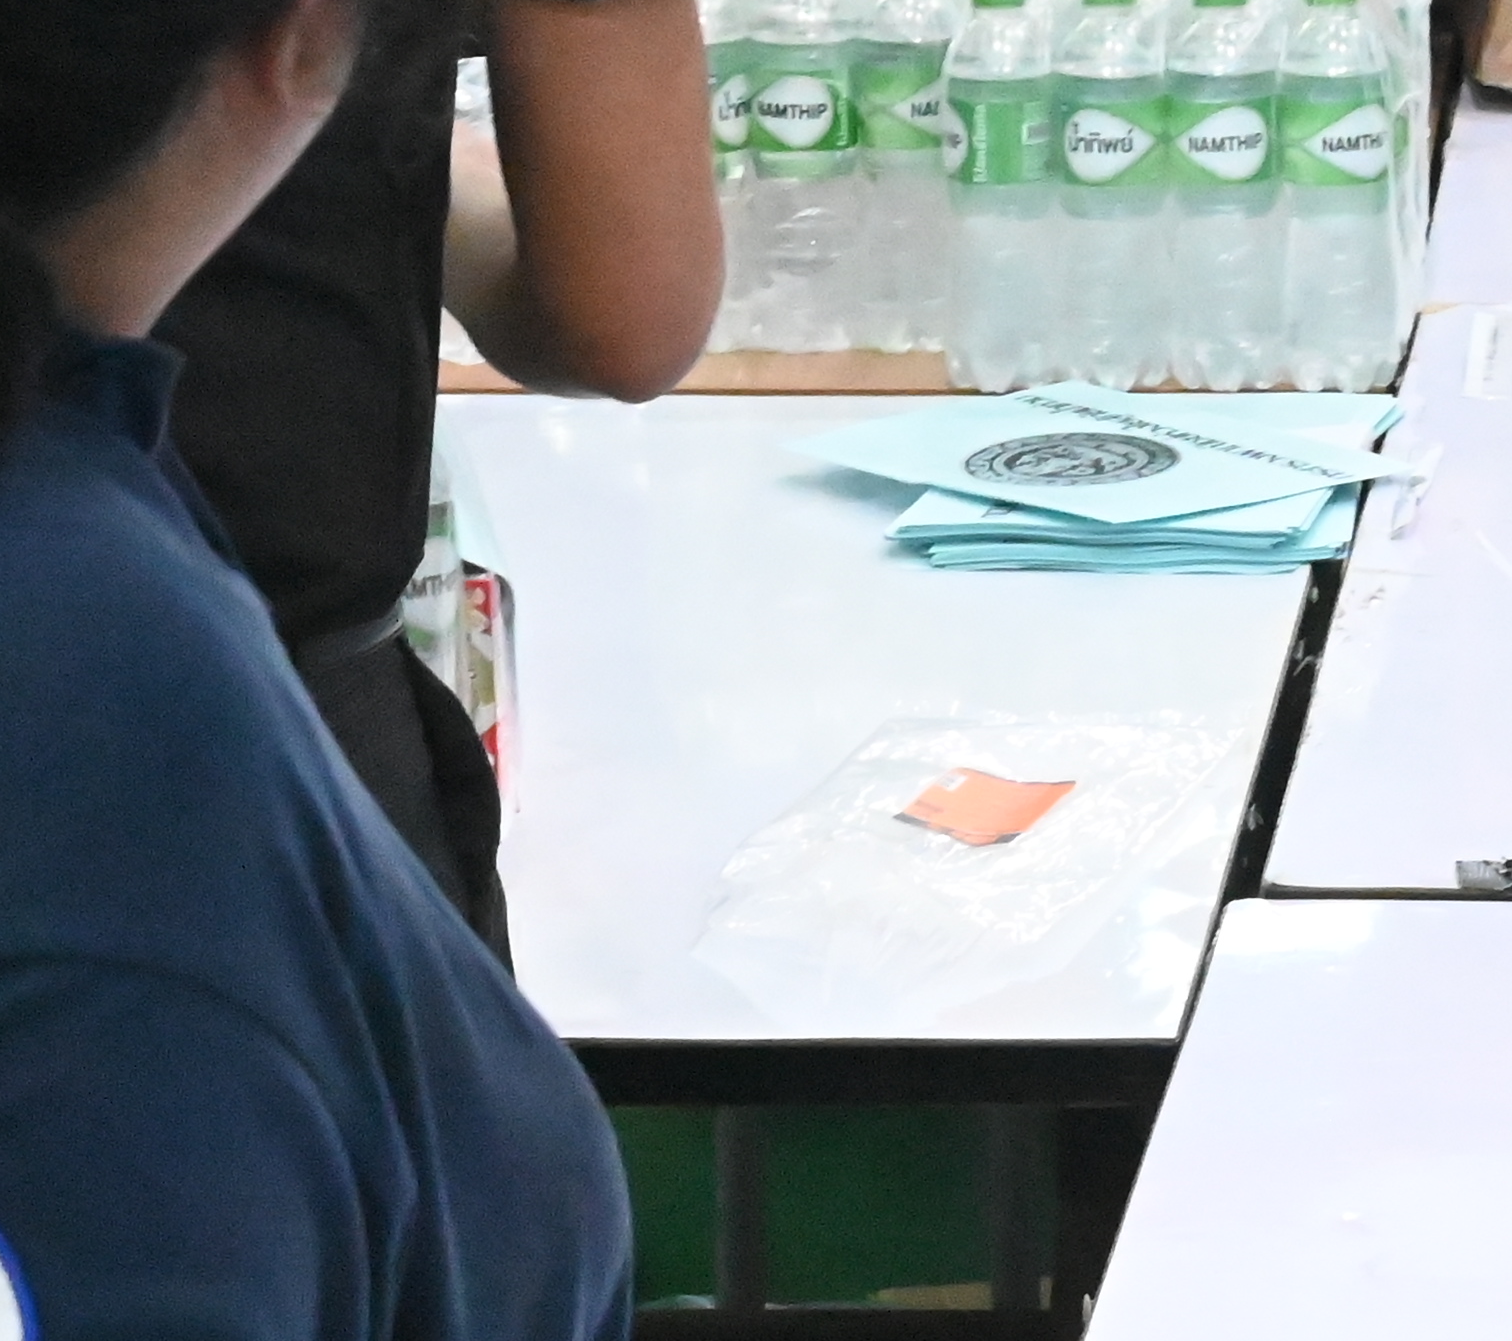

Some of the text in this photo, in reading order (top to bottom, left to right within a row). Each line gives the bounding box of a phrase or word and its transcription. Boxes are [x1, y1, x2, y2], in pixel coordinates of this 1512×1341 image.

[1068, 119, 1134, 154] น้ำทิพย์
[1187, 132, 1263, 153] NAMTHIP
